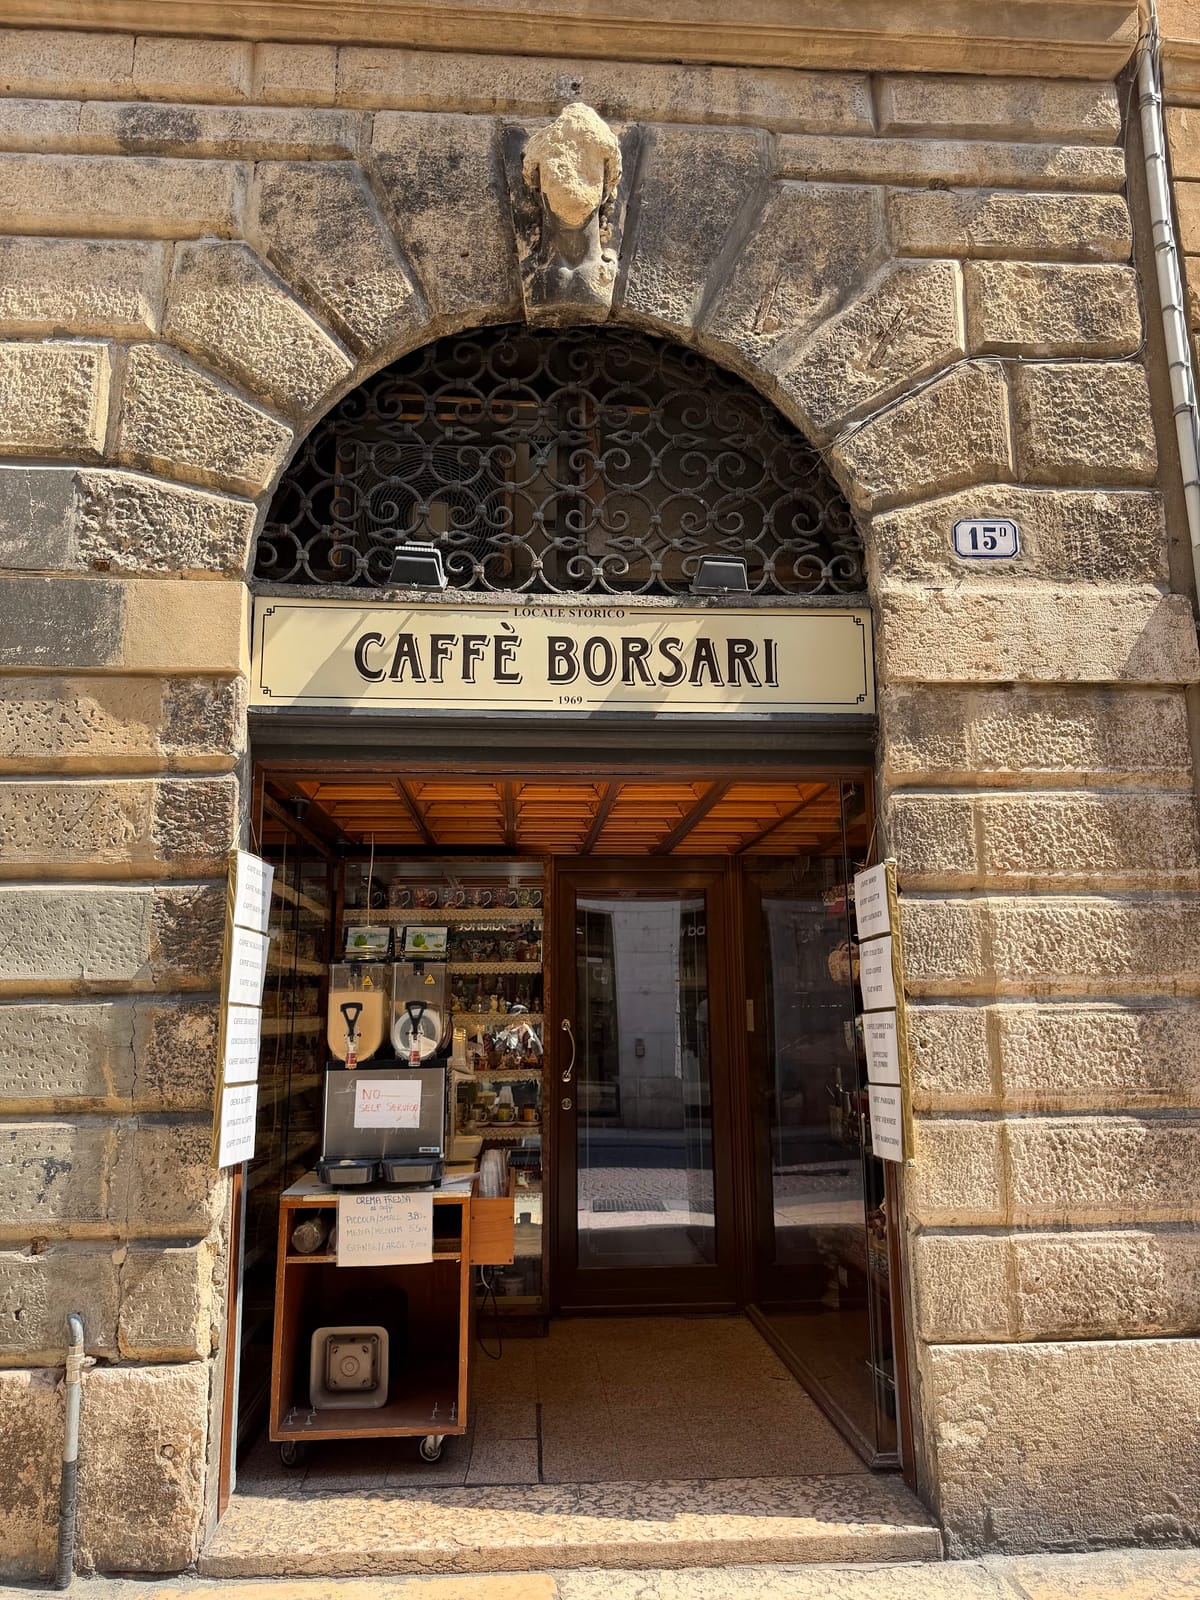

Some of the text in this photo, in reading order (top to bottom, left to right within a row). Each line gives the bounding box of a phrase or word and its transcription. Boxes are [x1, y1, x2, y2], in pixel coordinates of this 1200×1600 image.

[514, 607, 625, 619] LOCALE STORICO
[354, 621, 779, 687] CAFFÈ BORSARI
[558, 695, 583, 705] 1969
[356, 1196, 381, 1205] CREMA
